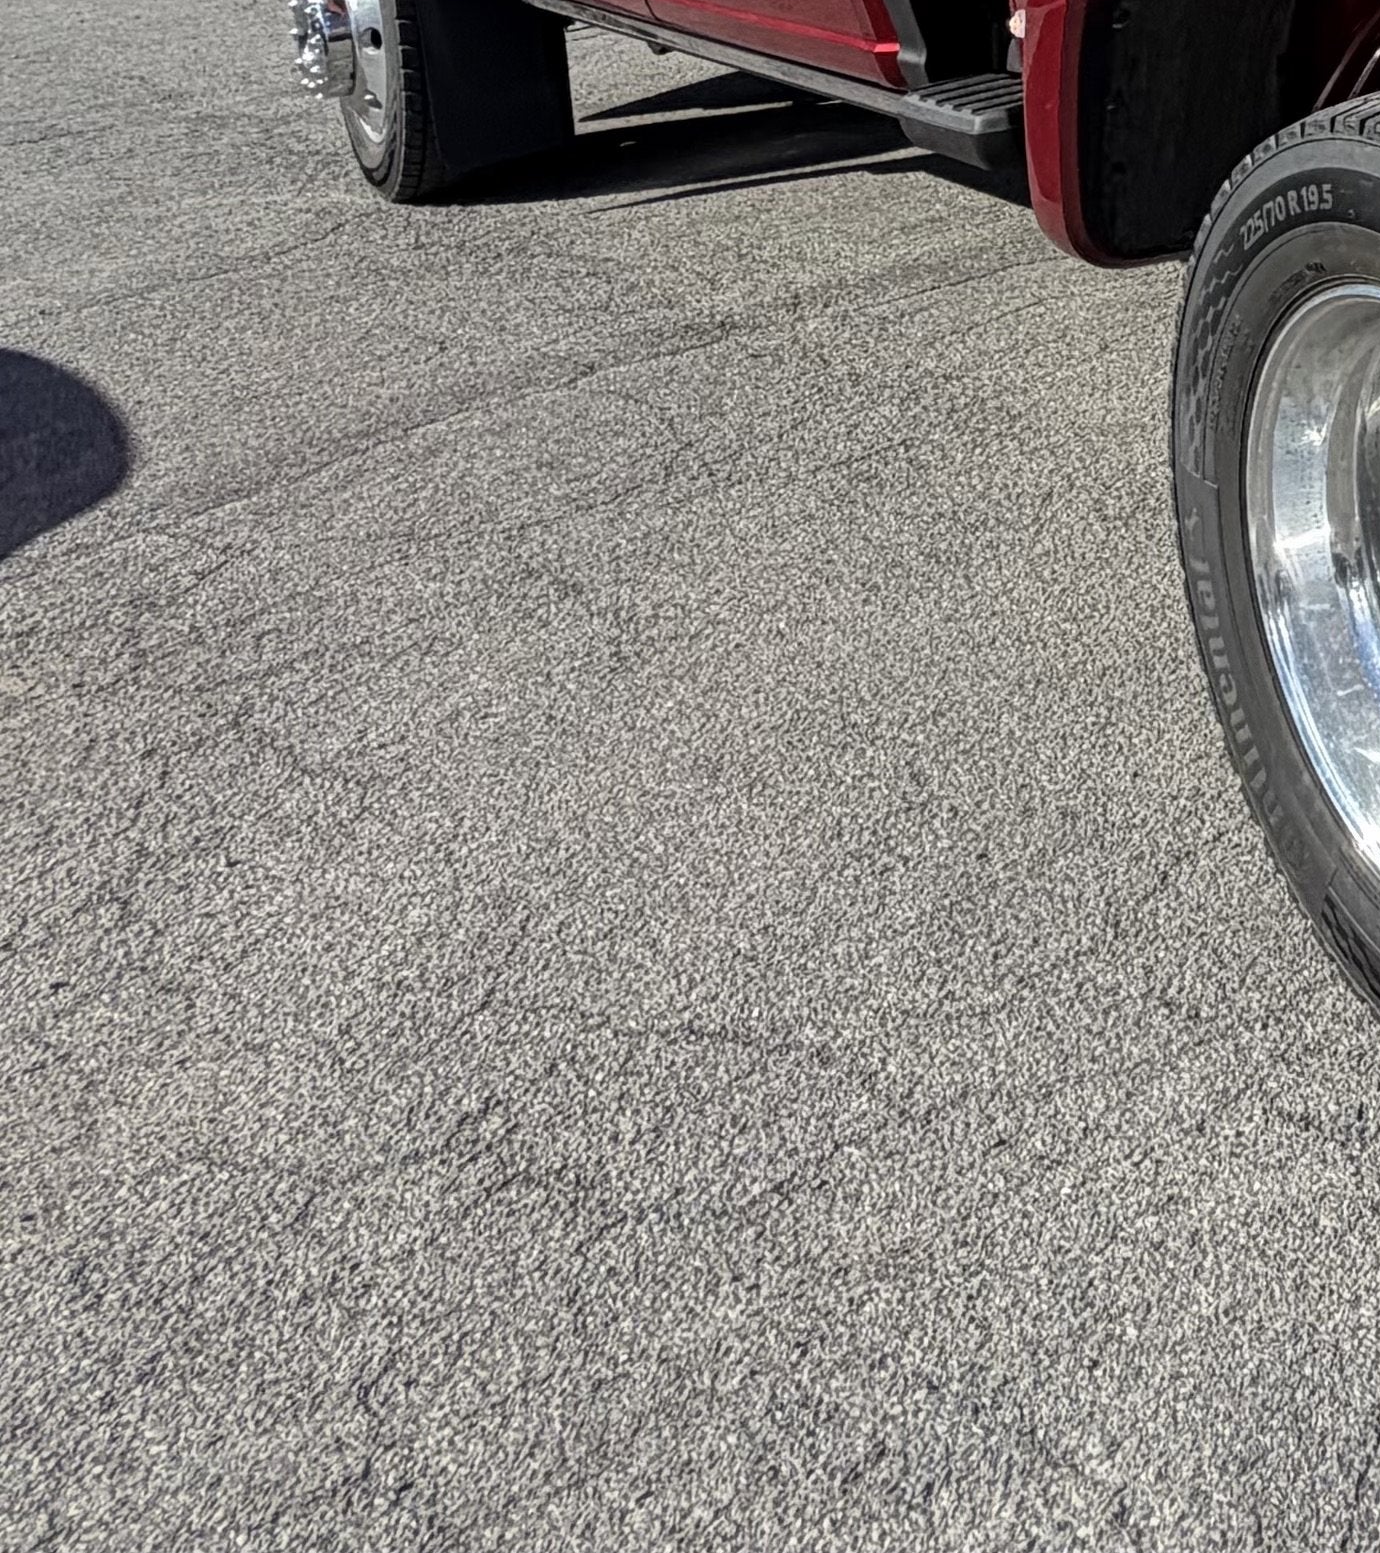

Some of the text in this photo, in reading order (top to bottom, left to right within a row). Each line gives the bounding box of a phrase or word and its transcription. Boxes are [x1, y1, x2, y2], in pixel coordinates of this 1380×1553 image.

[1239, 183, 1334, 251] 225/70 R 19.5
